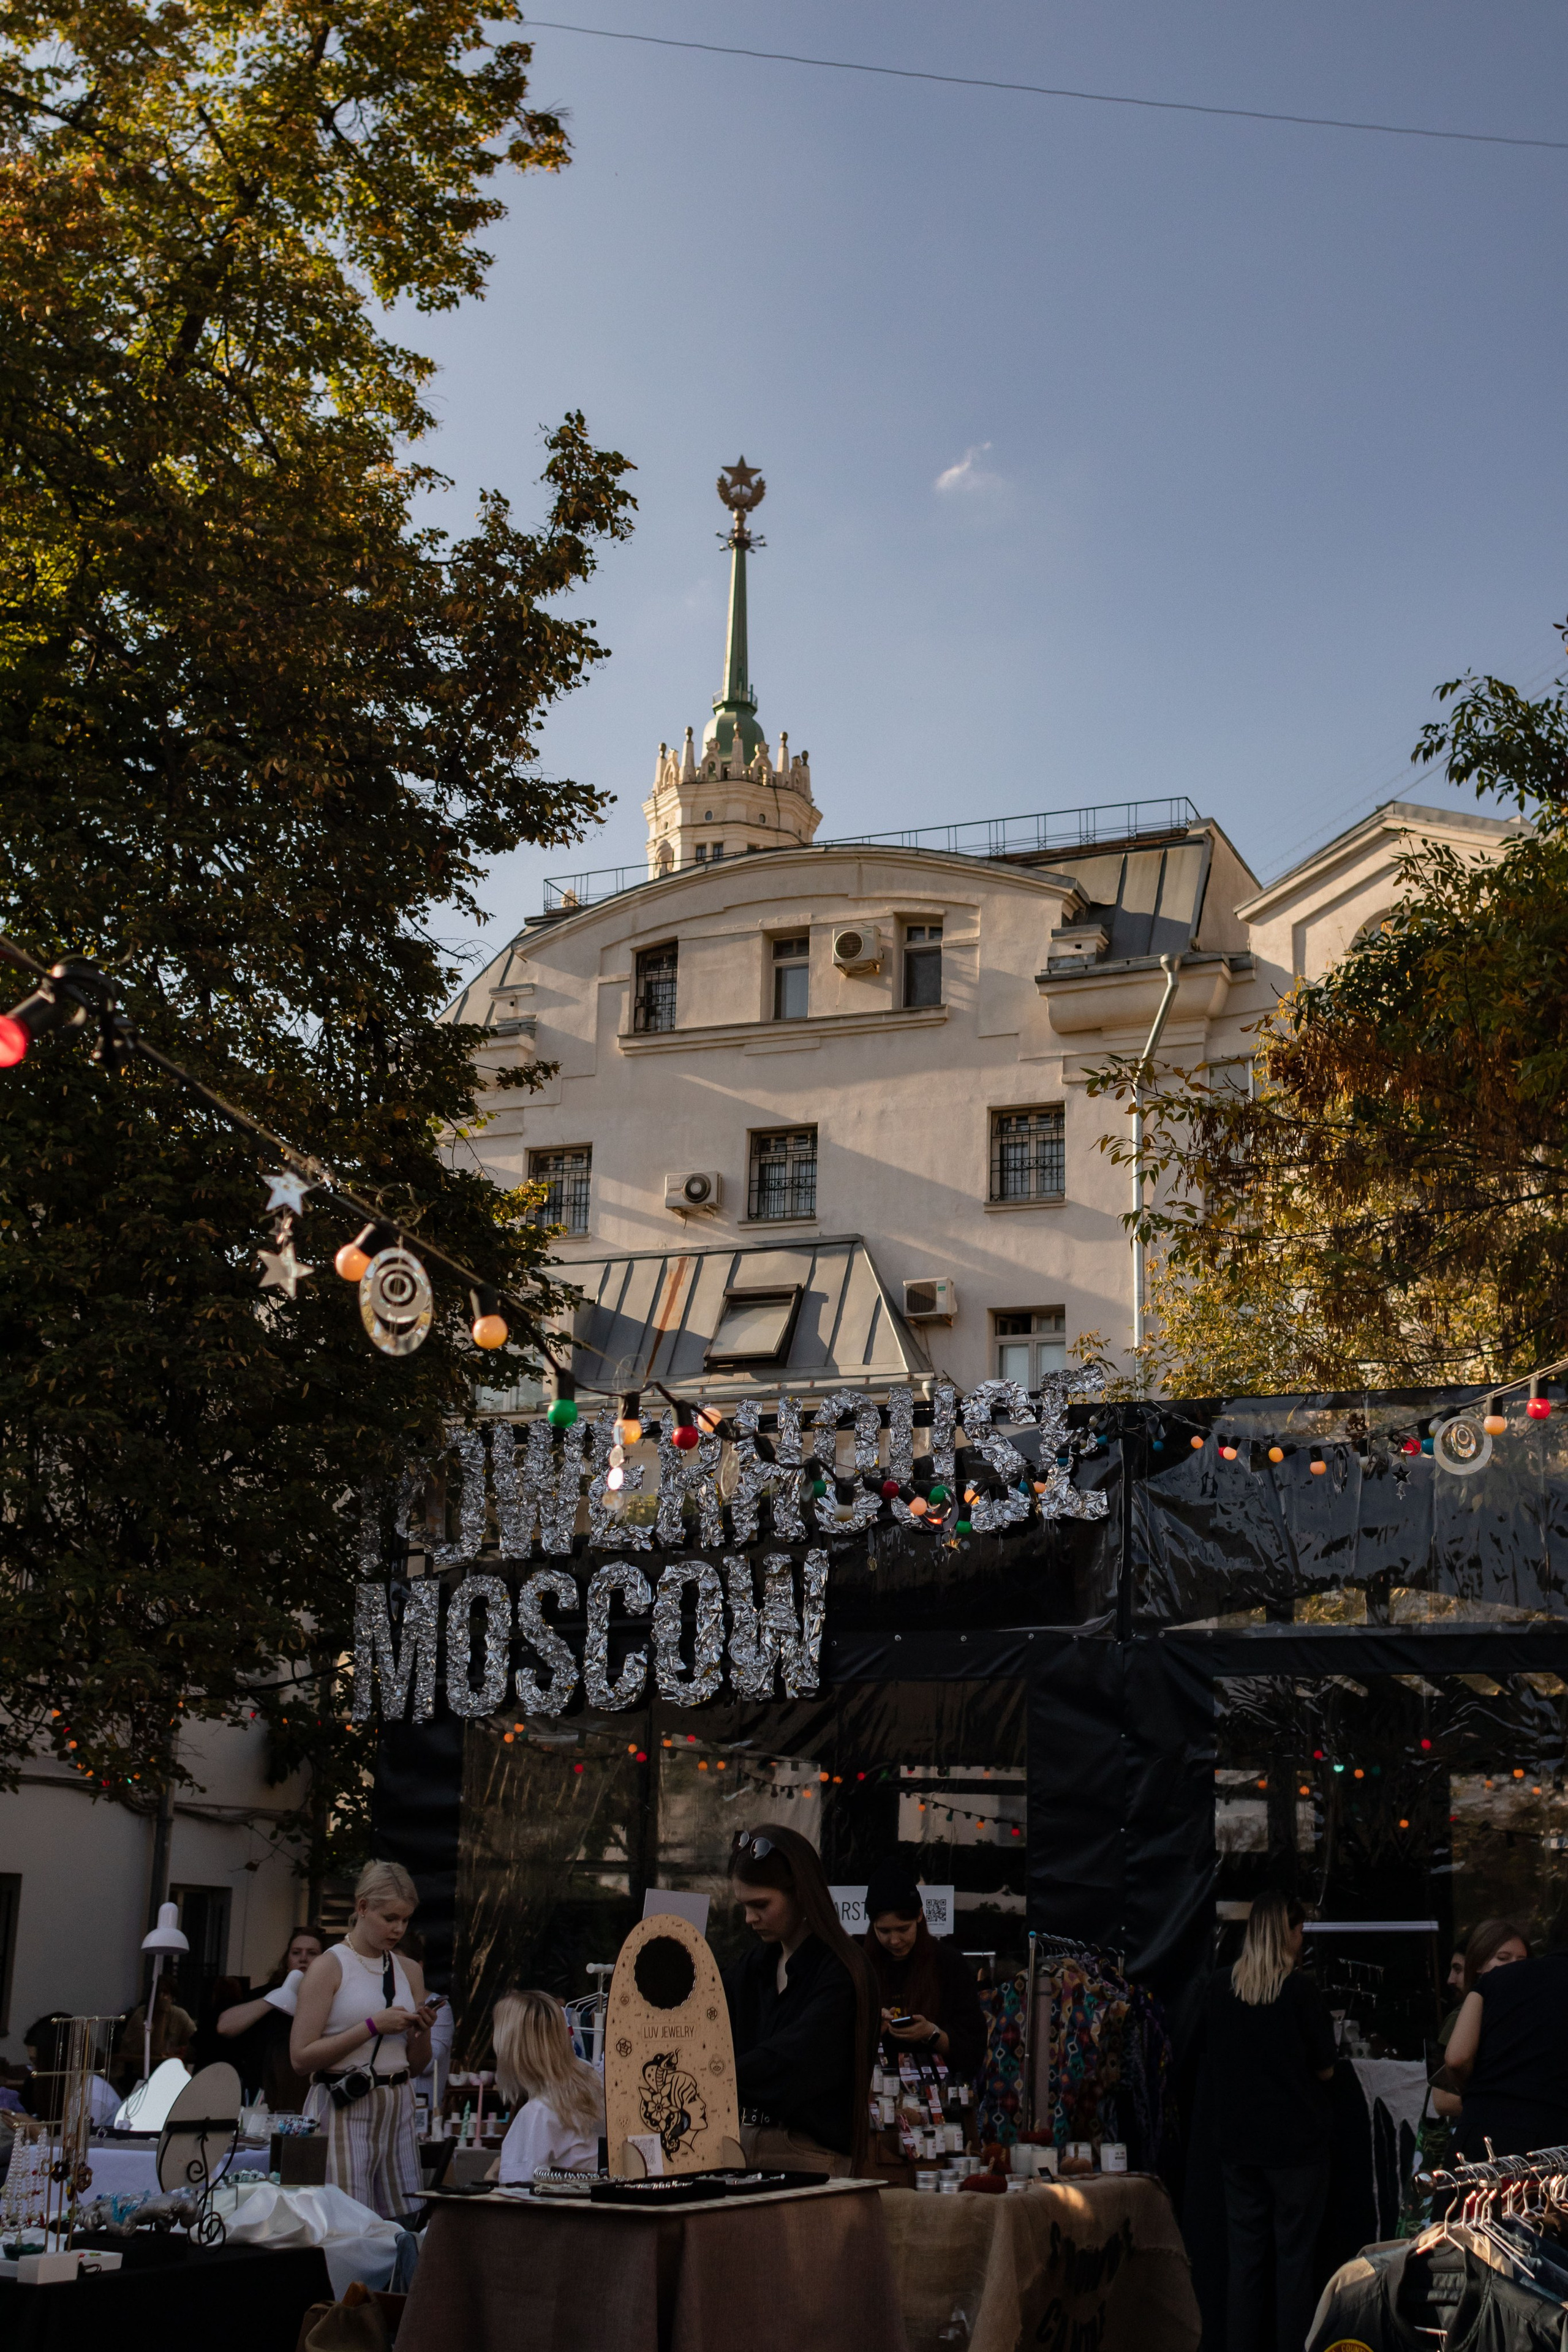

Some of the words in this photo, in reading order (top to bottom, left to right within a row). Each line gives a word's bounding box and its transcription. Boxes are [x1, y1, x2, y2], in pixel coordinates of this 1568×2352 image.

[353, 1548, 829, 1724] MOSCOW
[644, 2027, 658, 2038] LUV
[661, 2026, 695, 2038] JEWELRY
